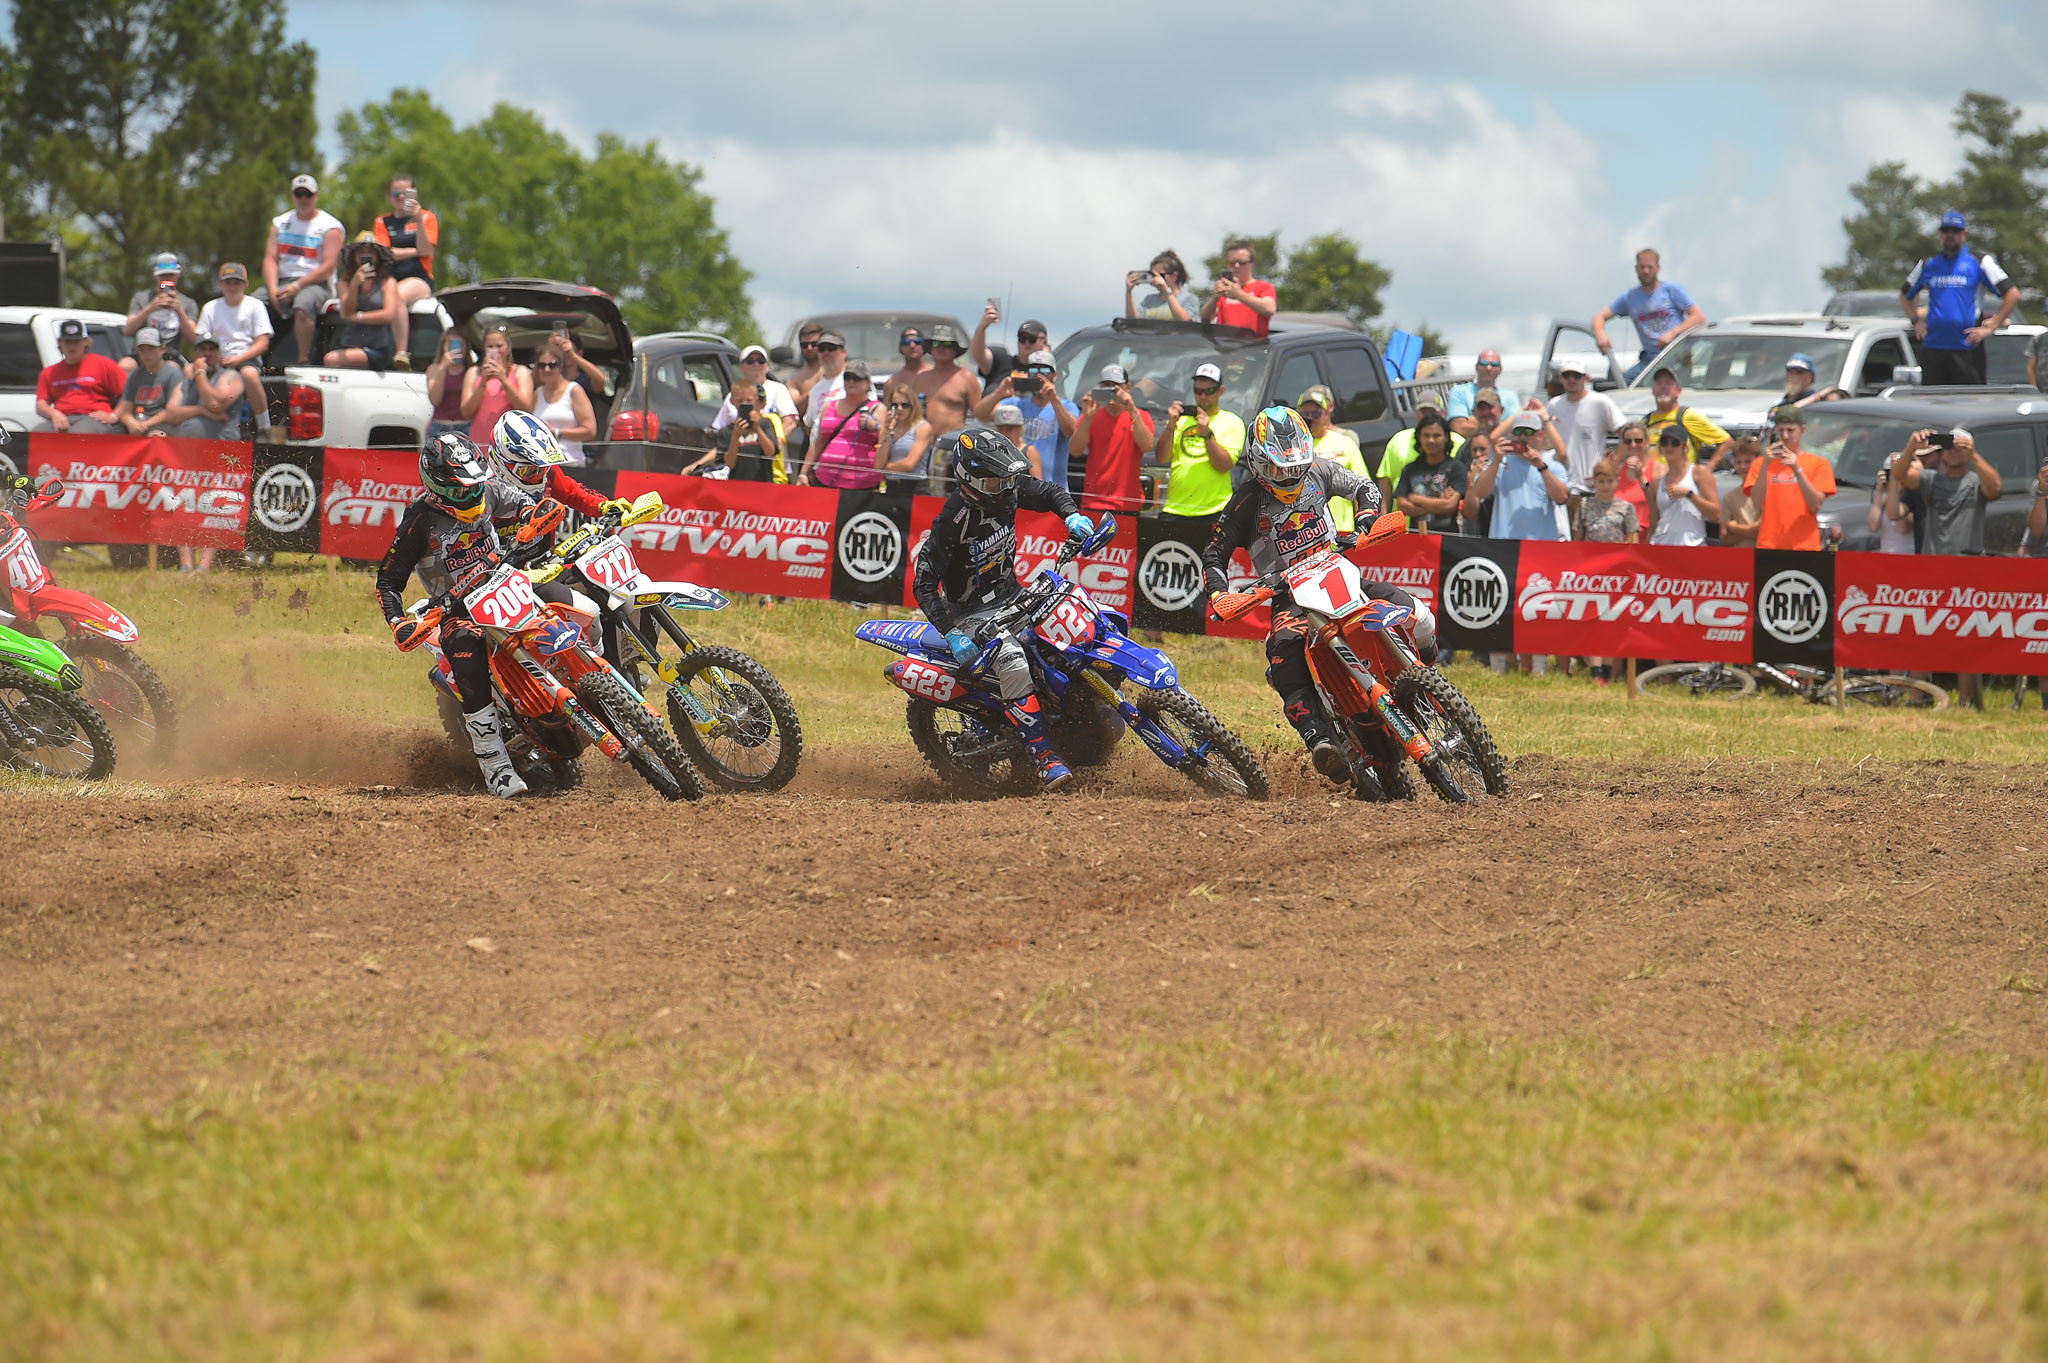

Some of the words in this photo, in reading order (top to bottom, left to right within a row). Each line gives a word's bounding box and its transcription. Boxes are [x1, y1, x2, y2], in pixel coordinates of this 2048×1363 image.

[66, 462, 137, 482] ROCKY
[137, 464, 247, 489] MOUNTAIN
[356, 478, 424, 501] ROCKY
[655, 504, 720, 528] ROCKY
[721, 509, 831, 537] MOUNTAIN
[1277, 531, 1304, 552] Red
[1303, 519, 1327, 541] Bull
[447, 550, 473, 570] Red
[472, 536, 494, 559] Bull
[850, 531, 889, 562] RM
[978, 525, 1010, 551] YAMAHA
[1020, 534, 1133, 565] MOAIN
[7, 540, 43, 590] 410
[593, 545, 639, 591] 212
[1152, 559, 1194, 590] RM
[1360, 566, 1435, 585] UNTAIN
[1319, 566, 1352, 610] 1
[1459, 579, 1495, 609] RM
[1556, 571, 1631, 594] ROCKY
[1631, 573, 1749, 599] MOUNTAIN
[1873, 584, 1945, 606] ROCKY
[482, 575, 534, 627] 206
[1773, 592, 1813, 621] RM
[875, 638, 908, 653] DUNLOP
[901, 662, 956, 701] 523
[669, 687, 699, 721] MAXXIS
[1383, 694, 1419, 734] DNLOP
[1383, 709, 1410, 742] MOTOREX
